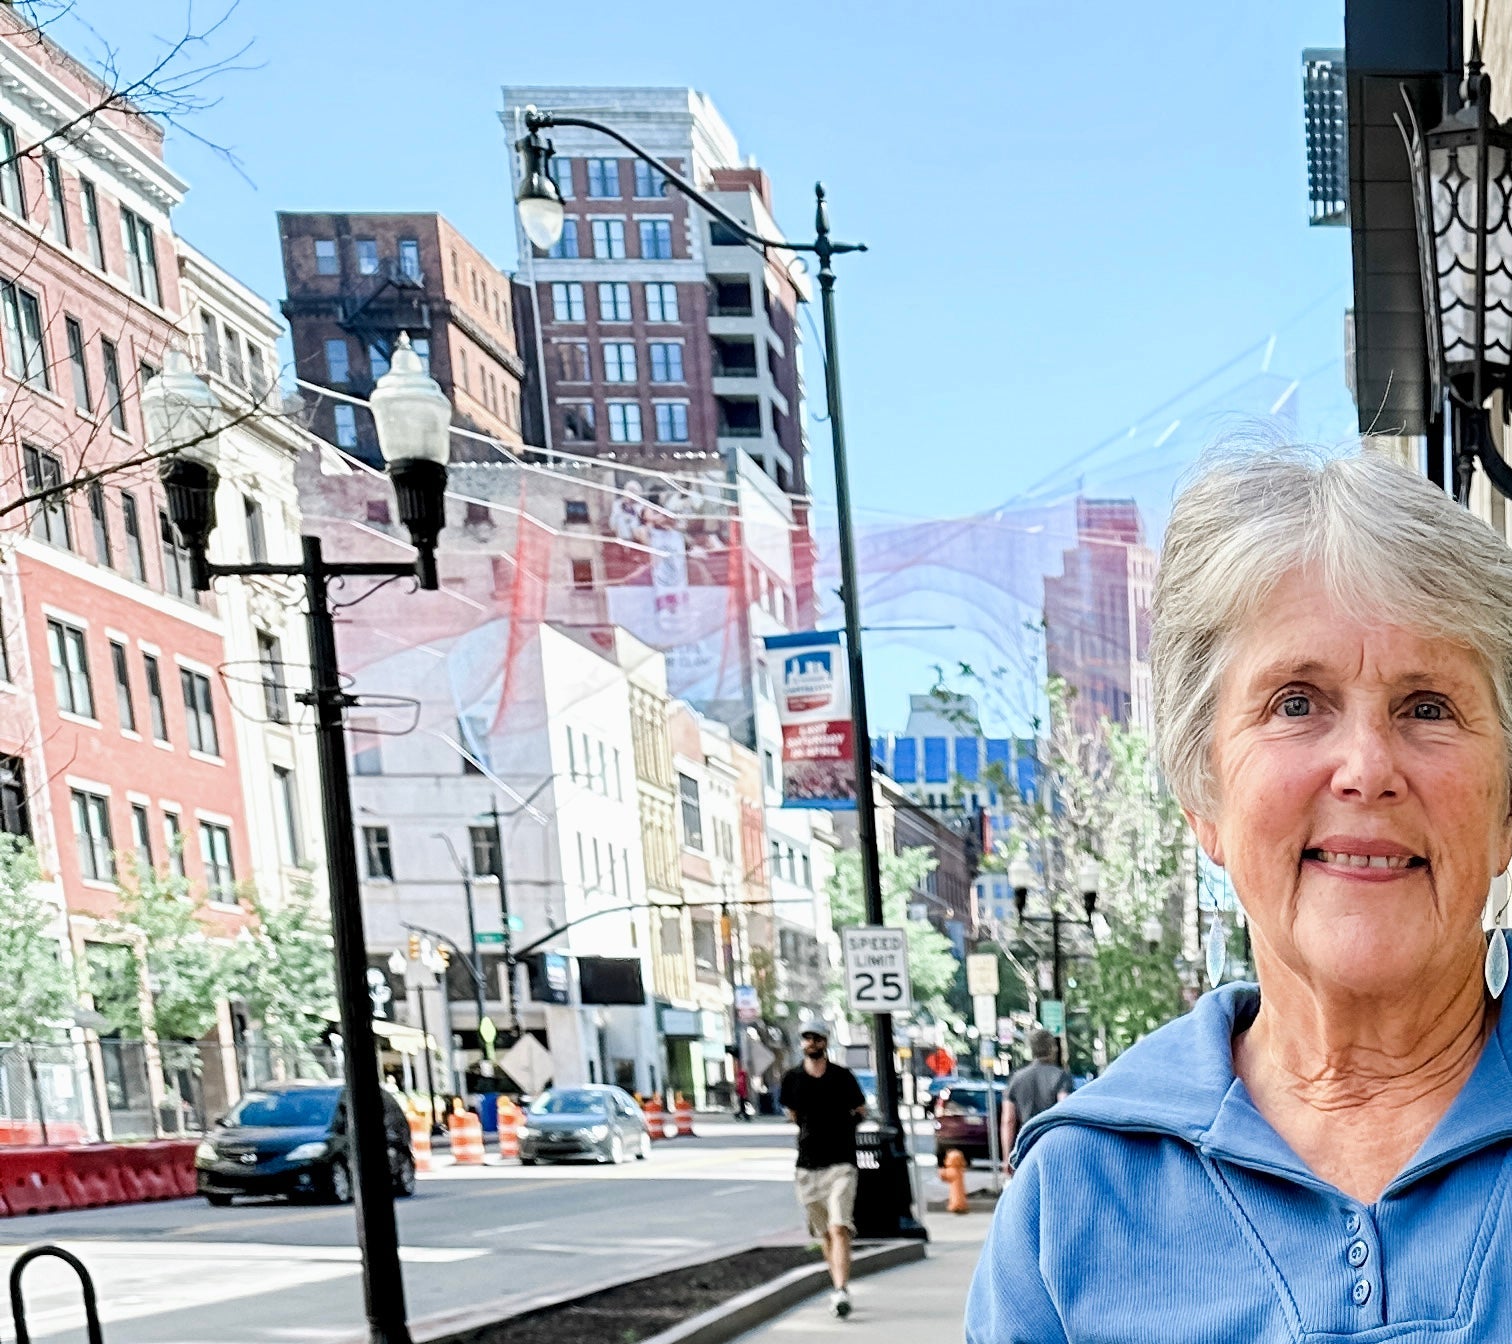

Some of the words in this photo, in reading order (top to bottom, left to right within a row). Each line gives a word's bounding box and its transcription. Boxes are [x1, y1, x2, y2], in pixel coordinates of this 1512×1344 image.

[848, 938, 900, 950] SPEED
[854, 954, 896, 967] LIMIT
[855, 973, 902, 1001] 25
